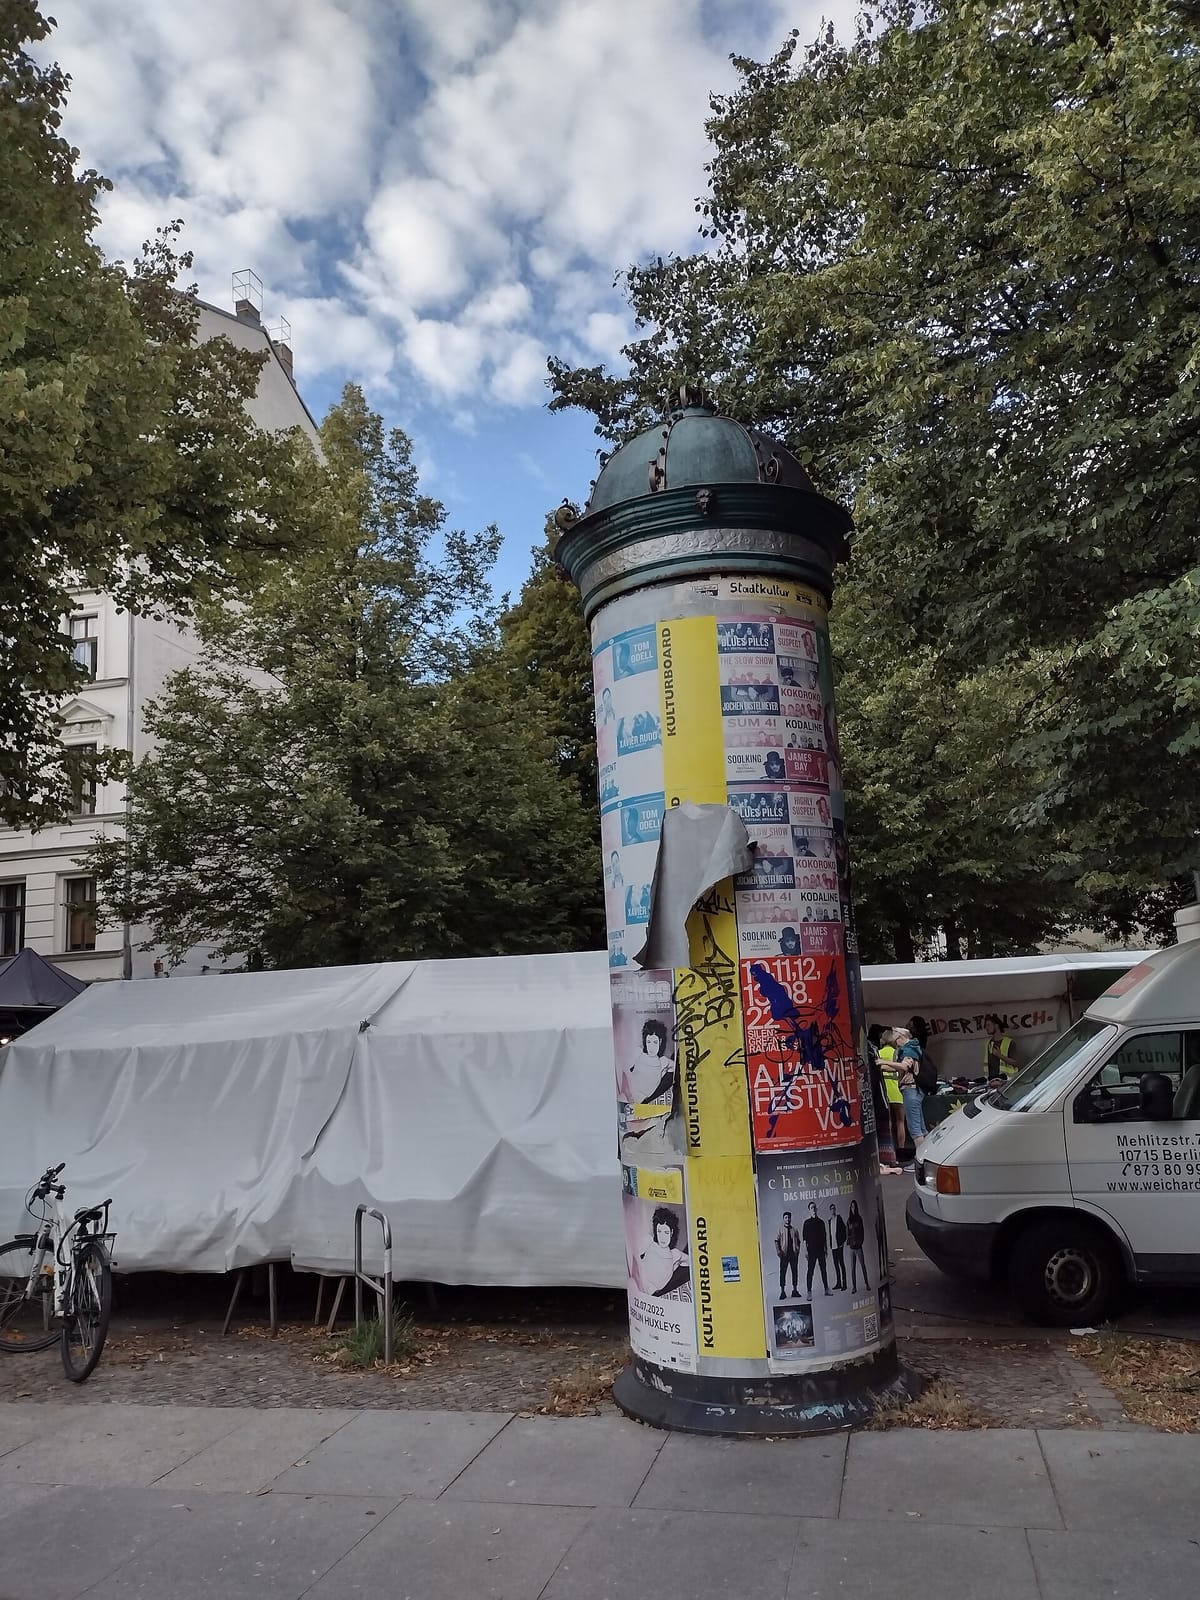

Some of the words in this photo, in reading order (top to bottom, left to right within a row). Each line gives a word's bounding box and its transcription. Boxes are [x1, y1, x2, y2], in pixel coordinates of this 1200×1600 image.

[730, 582, 790, 598] Stadtkultur
[779, 628, 799, 638] HIGHLY
[633, 640, 650, 652] TOM
[721, 637, 747, 647] BLUES
[748, 637, 769, 647] PILLS
[777, 638, 802, 649] SUSPECT
[630, 653, 654, 664] ODELL
[720, 656, 733, 666] THE
[733, 656, 753, 665] SLOW
[755, 656, 774, 665] SHOW
[661, 627, 677, 737] KULTURBOARD
[781, 687, 821, 702] KOKOROKO
[722, 702, 744, 711] JOCHEN
[727, 718, 760, 728] SUM
[785, 719, 823, 733] KODALINE
[619, 733, 639, 749] XAVIER
[639, 731, 658, 744] RUDD
[727, 754, 762, 764] SOOLKING
[787, 752, 813, 763] JAMES
[794, 761, 808, 772] BAY
[794, 796, 813, 806] HIGHLY
[642, 809, 658, 821] TOM
[762, 807, 784, 818] PILLS
[792, 807, 817, 817] SUSPECT
[770, 826, 788, 837] SHOW
[796, 858, 836, 870] KOKOROKO
[742, 892, 774, 903] SUM
[800, 891, 838, 903] KODALINE
[742, 931, 777, 941] SOOLKING
[803, 926, 828, 937] JAMES
[809, 936, 824, 946] BAY
[746, 1006, 780, 1030] 22
[684, 1024, 701, 1148] KULTURBOARD
[754, 1080, 857, 1113] FESTIVAL
[1120, 1149, 1159, 1162] 10715
[1162, 1148, 1200, 1161] Berli
[1134, 1164, 1160, 1176] 873
[1164, 1163, 1182, 1176] 80
[768, 1169, 861, 1190] chaosbay
[783, 1191, 798, 1202] DAS
[800, 1190, 817, 1201] NEUE
[818, 1186, 840, 1199] ALBUM
[696, 1216, 714, 1348] KULTURBOARD
[644, 1316, 681, 1334] HUXLEYS
